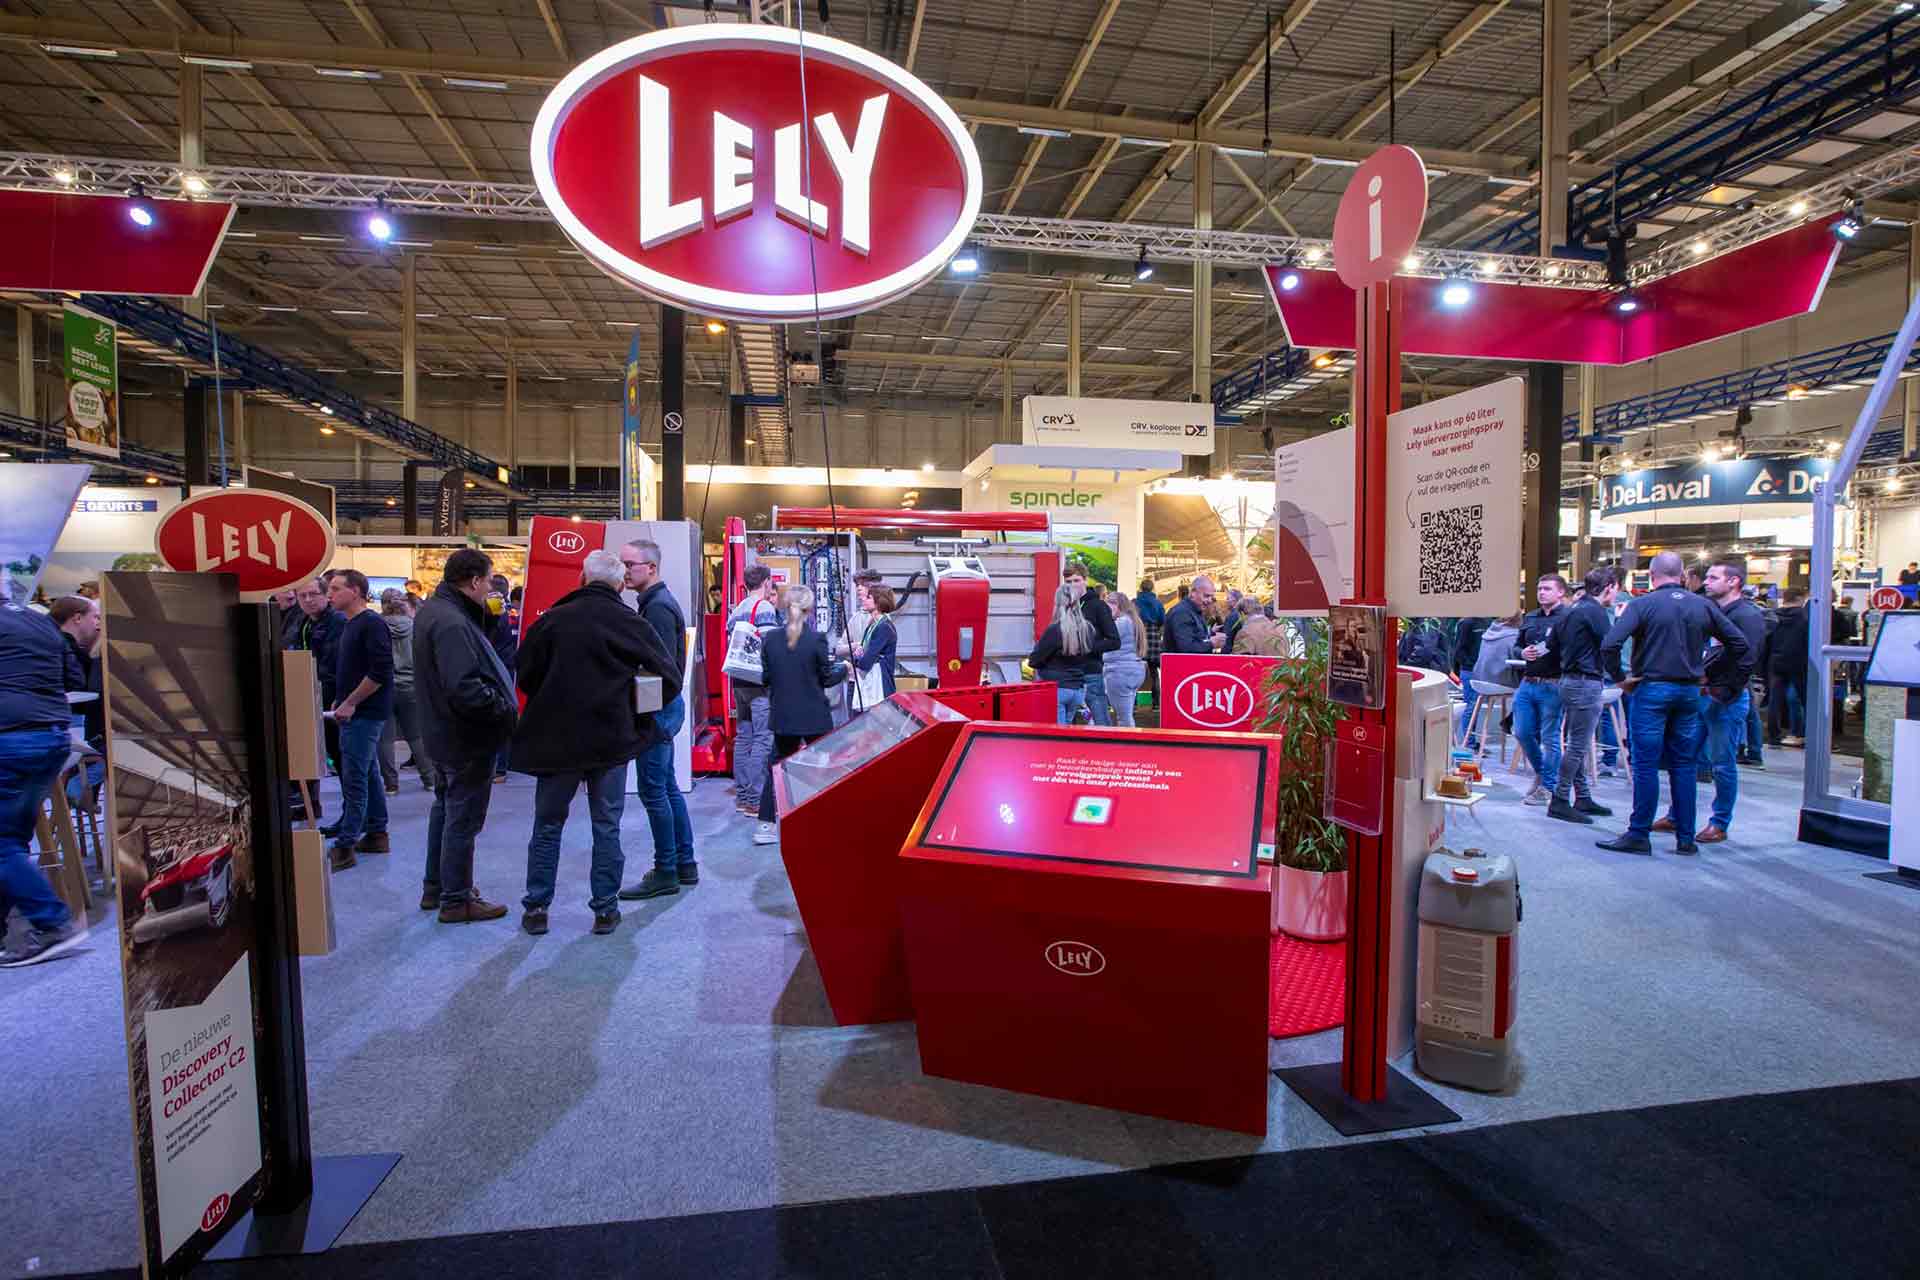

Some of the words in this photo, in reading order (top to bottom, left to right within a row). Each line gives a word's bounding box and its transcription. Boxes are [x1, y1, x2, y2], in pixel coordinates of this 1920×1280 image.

[640, 74, 889, 256] LELY
[1042, 415, 1063, 424] CRV
[1412, 424, 1433, 435] Maak
[1434, 420, 1452, 430] kans
[1454, 417, 1464, 426] op
[1465, 412, 1476, 422] 60
[1477, 408, 1496, 418] liter
[1407, 440, 1422, 450] Lely
[1432, 447, 1448, 457] naar
[1417, 471, 1433, 483] Scan
[1434, 470, 1444, 480] de
[1445, 464, 1478, 479] QR-code
[1480, 462, 1490, 471] en
[1009, 487, 1103, 509] spinder
[1418, 486, 1428, 496] vul
[1429, 485, 1439, 494] de
[1440, 477, 1479, 492] vragenlijst
[1612, 474, 1711, 508] DeLaval
[192, 510, 292, 573] LELY
[1192, 682, 1238, 716] LELY
[1069, 777, 1085, 785] van
[1125, 767, 1153, 776] indien
[1154, 769, 1163, 778] je
[1057, 946, 1092, 970] LELY
[160, 1048, 181, 1072] De
[184, 1014, 231, 1056] nieuwe
[162, 1034, 232, 1096] Discovery
[164, 1062, 227, 1118] Collector
[229, 1046, 246, 1068] C2
